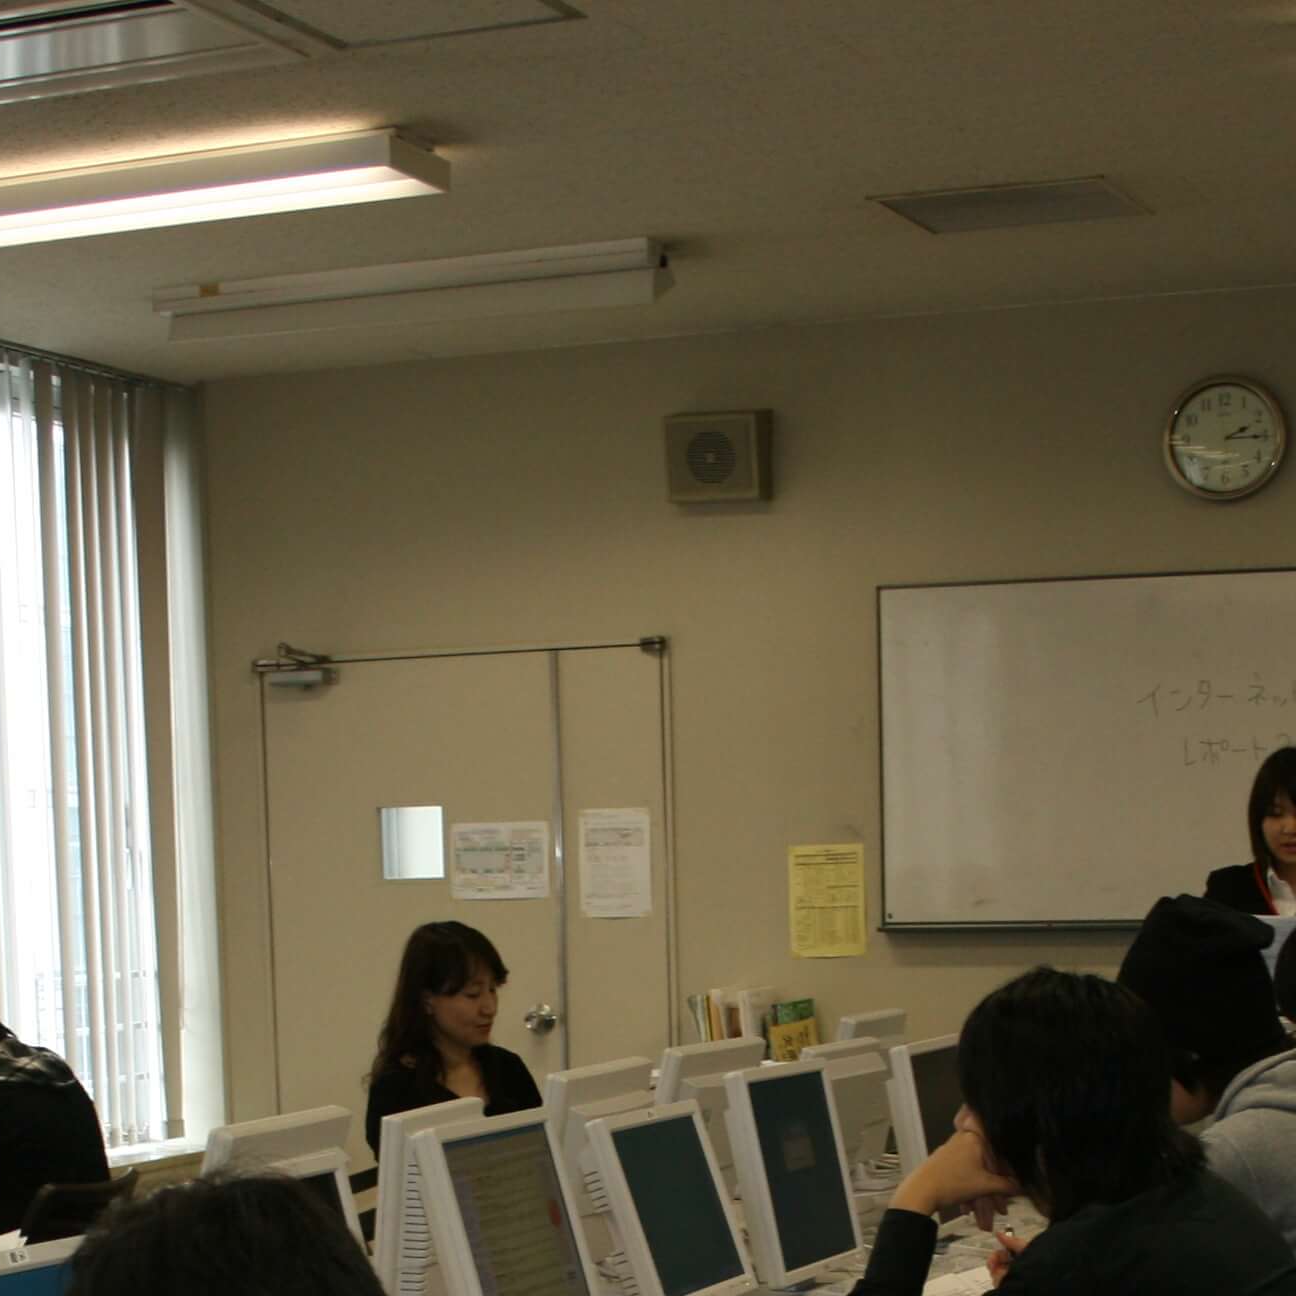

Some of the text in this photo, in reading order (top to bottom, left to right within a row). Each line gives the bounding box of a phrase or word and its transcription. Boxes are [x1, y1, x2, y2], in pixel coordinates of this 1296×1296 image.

[1202, 399, 1211, 411] 11
[1218, 391, 1232, 406] 12
[1185, 415, 1198, 426] 10
[1255, 410, 1263, 423] 2
[1254, 449, 1262, 464] 4
[1221, 470, 1230, 485] 6
[1182, 735, 1268, 768] レポート
